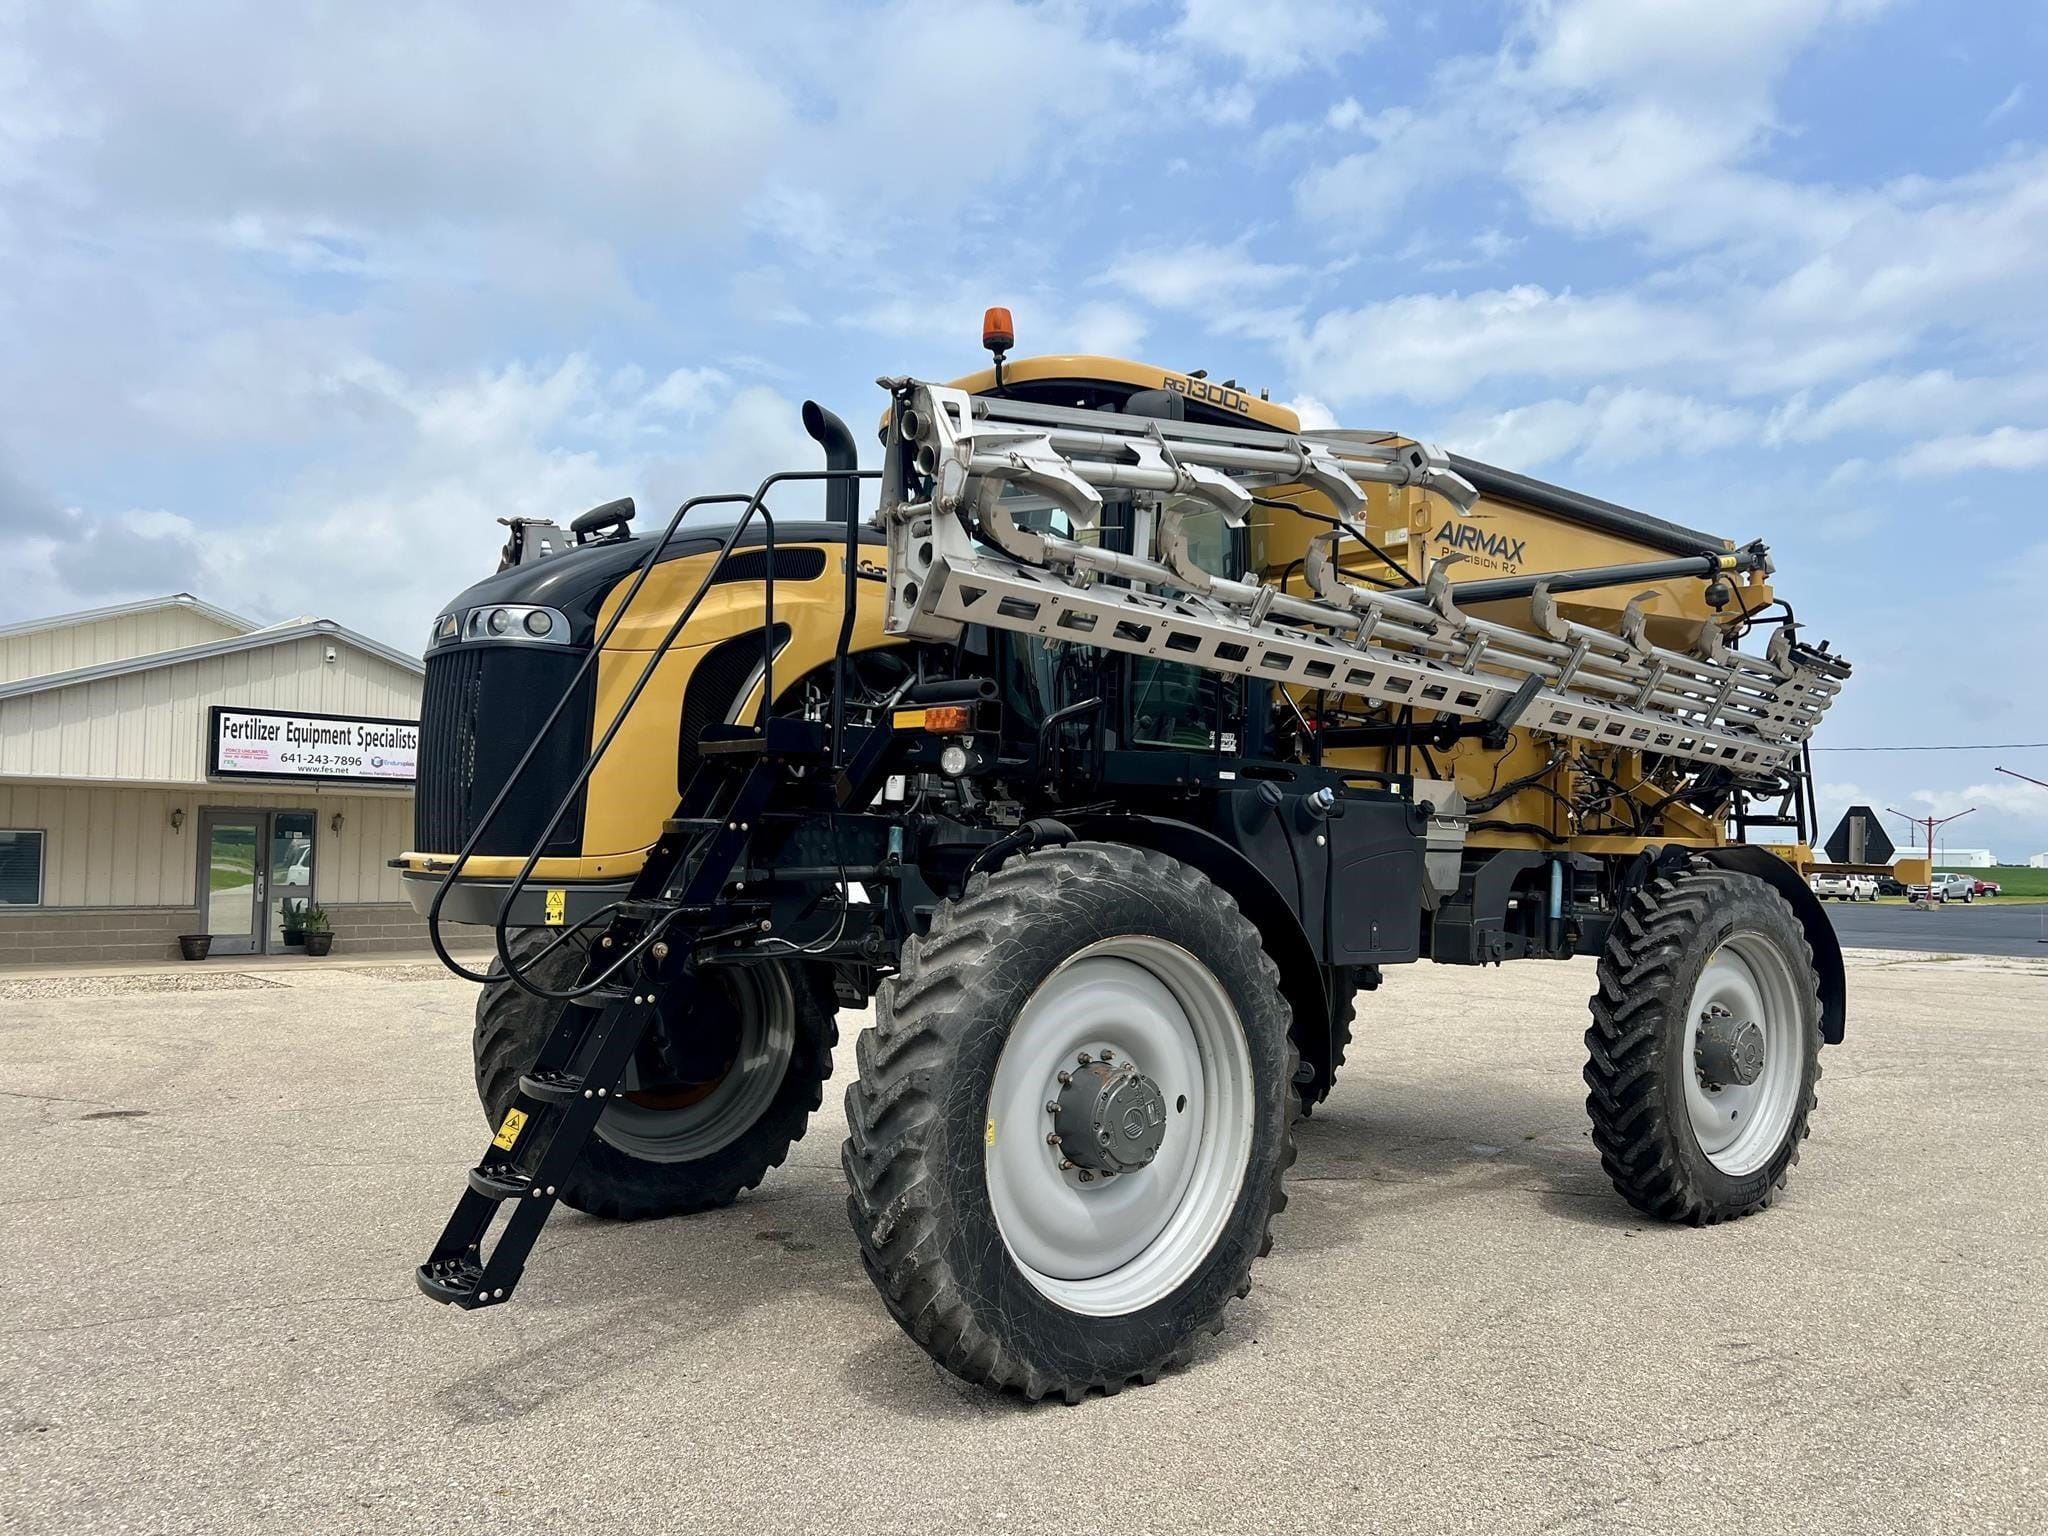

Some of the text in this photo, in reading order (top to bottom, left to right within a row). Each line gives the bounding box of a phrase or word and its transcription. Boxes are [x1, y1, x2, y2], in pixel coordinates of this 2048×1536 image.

[1434, 520, 1526, 565] AIRMAX
[1441, 546, 1517, 575] PISION R2
[223, 717, 417, 752] Fertilizer Equipment Specialists
[280, 752, 362, 767] 641-243-7896
[297, 765, 349, 774] www.fes.net
